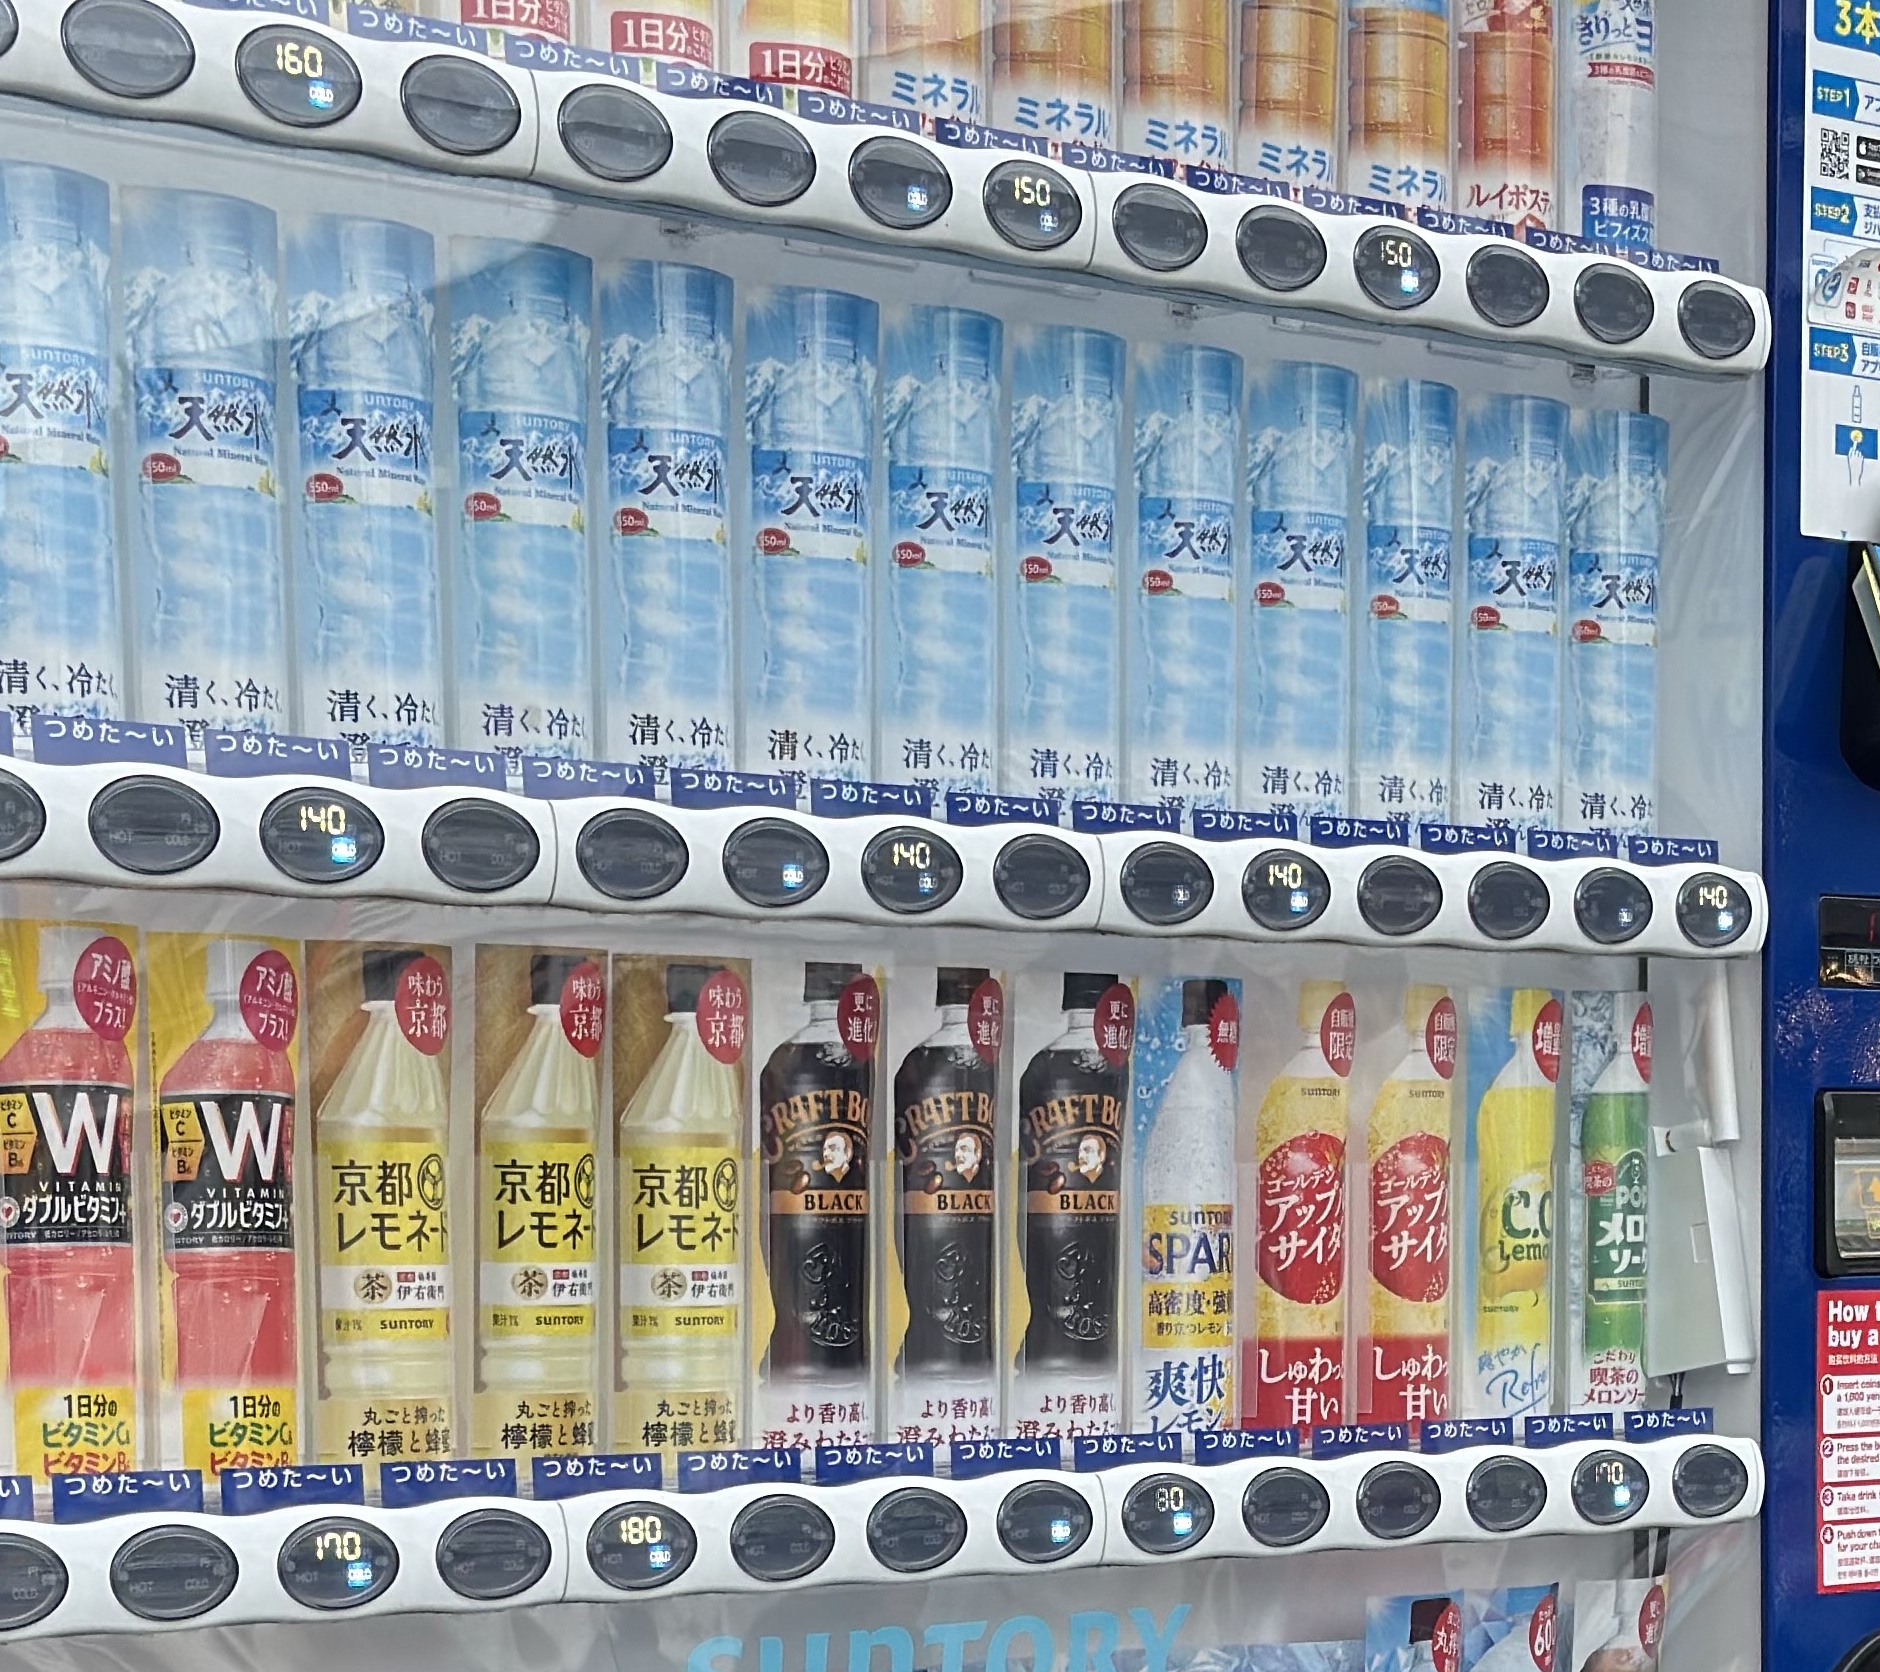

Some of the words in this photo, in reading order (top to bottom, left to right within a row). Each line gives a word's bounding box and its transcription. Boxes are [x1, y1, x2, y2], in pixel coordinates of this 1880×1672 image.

[276, 43, 323, 78] 160
[1015, 176, 1050, 206] 150
[300, 806, 346, 834] 140
[892, 842, 930, 868] 140
[1268, 862, 1301, 888] 140
[1698, 886, 1727, 908] 140
[408, 972, 443, 999] 味わう
[407, 1000, 446, 1040] 京都
[706, 1014, 744, 1048] 京都
[32, 1092, 118, 1175] W
[175, 1121, 186, 1136] C
[200, 1101, 282, 1181] W
[332, 1159, 412, 1207] 京都
[494, 1159, 570, 1206] 京都
[804, 1192, 863, 1211] BLACK
[937, 1191, 991, 1211] BLACK
[1060, 1191, 1116, 1210] BLACK
[359, 1273, 388, 1300] 茶
[518, 1271, 543, 1297] 茶
[380, 1318, 434, 1330] SUNTORY
[1828, 1300, 1869, 1322] How
[1828, 1325, 1862, 1349] buy
[1867, 1328, 1879, 1346] a
[1145, 1354, 1225, 1412] 爽快
[1590, 1367, 1637, 1385] 喫茶の
[63, 1395, 117, 1418] 1日分の
[229, 1395, 280, 1418] 1日分の
[1286, 1388, 1338, 1424] 甘い
[620, 1516, 661, 1545] 180
[316, 1531, 361, 1561] 170
